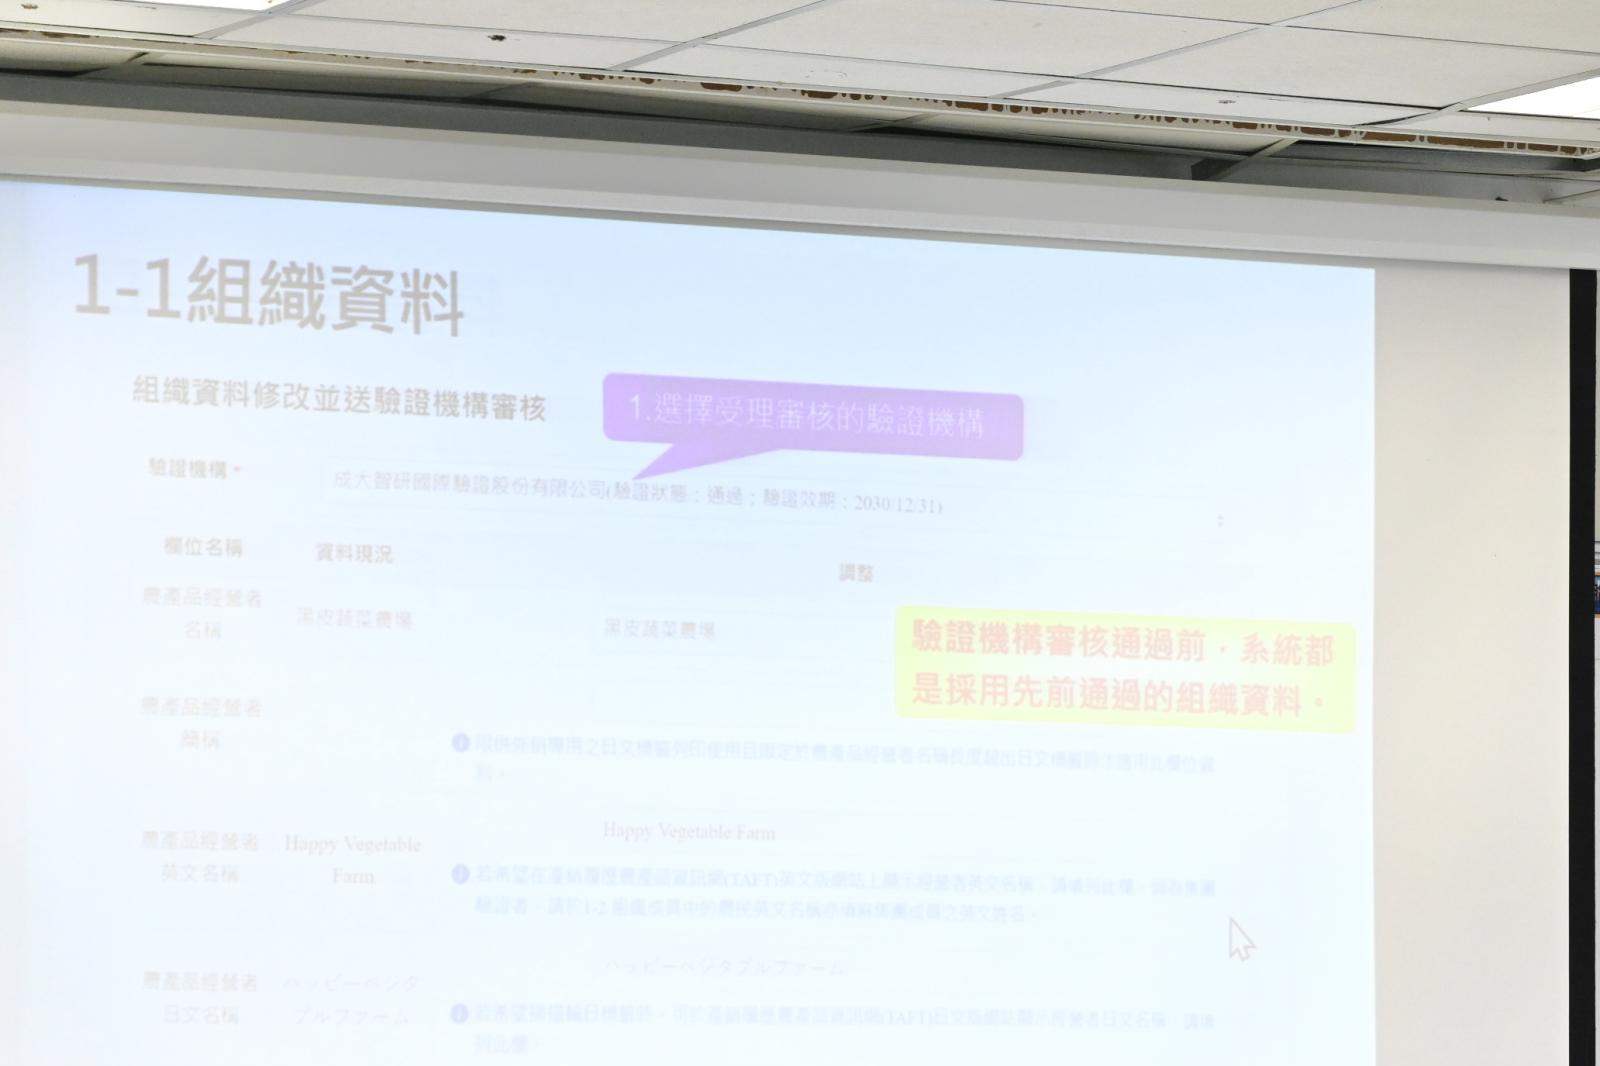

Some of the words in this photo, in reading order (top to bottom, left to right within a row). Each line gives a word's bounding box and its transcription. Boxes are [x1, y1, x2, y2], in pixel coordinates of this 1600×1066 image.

[72, 252, 465, 337] 1-1組織資料
[132, 374, 547, 423] 組織資料修改並送驗證機構審核
[627, 391, 985, 440] 1.選擇受理審核的驗證機構
[163, 534, 244, 560] 欄位名稱
[315, 540, 395, 566] 資料現況
[911, 672, 1330, 718] 是採用先前通過的組織資料。
[284, 834, 338, 856] Happy
[344, 835, 422, 856] Vegetable
[602, 820, 654, 842] Happy
[658, 822, 733, 844] Vegetable
[736, 824, 776, 841] Farm
[332, 867, 376, 885] Farm
